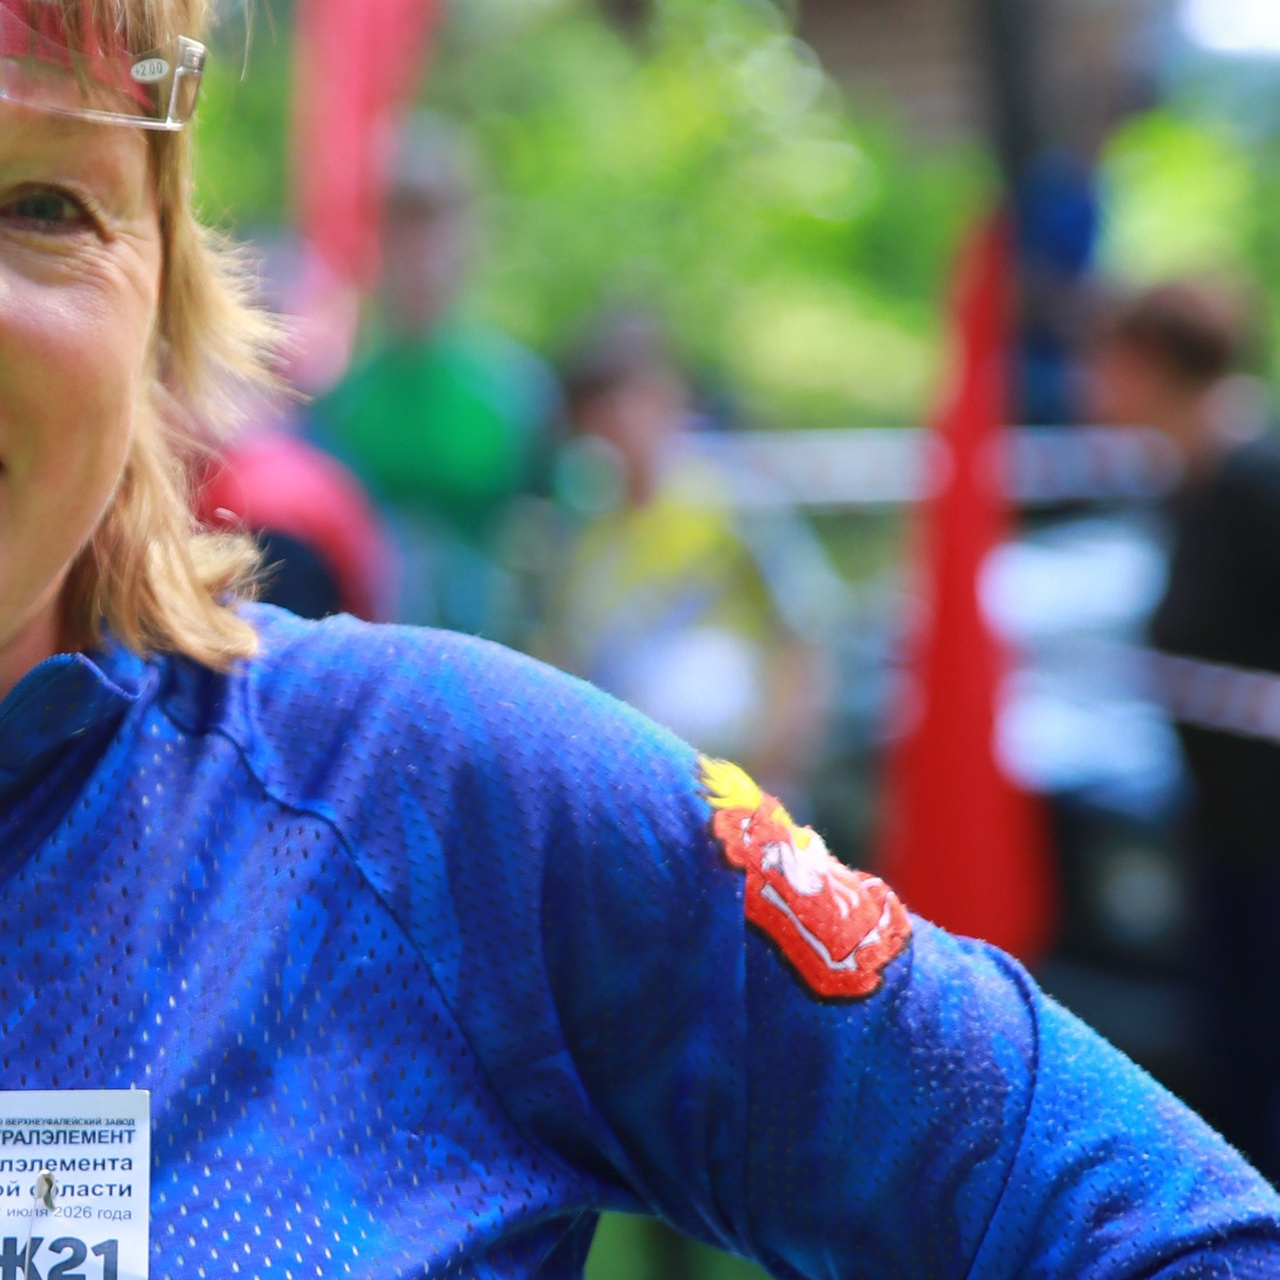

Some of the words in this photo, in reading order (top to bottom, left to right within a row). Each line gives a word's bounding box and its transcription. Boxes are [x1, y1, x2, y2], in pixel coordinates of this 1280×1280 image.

[6, 1117, 102, 1126] ВЕРХНЕУФАЛЕЙСКИЙ
[104, 1118, 136, 1126] ЗАВОД
[53, 1206, 92, 1219] 2026
[97, 1209, 132, 1222] года
